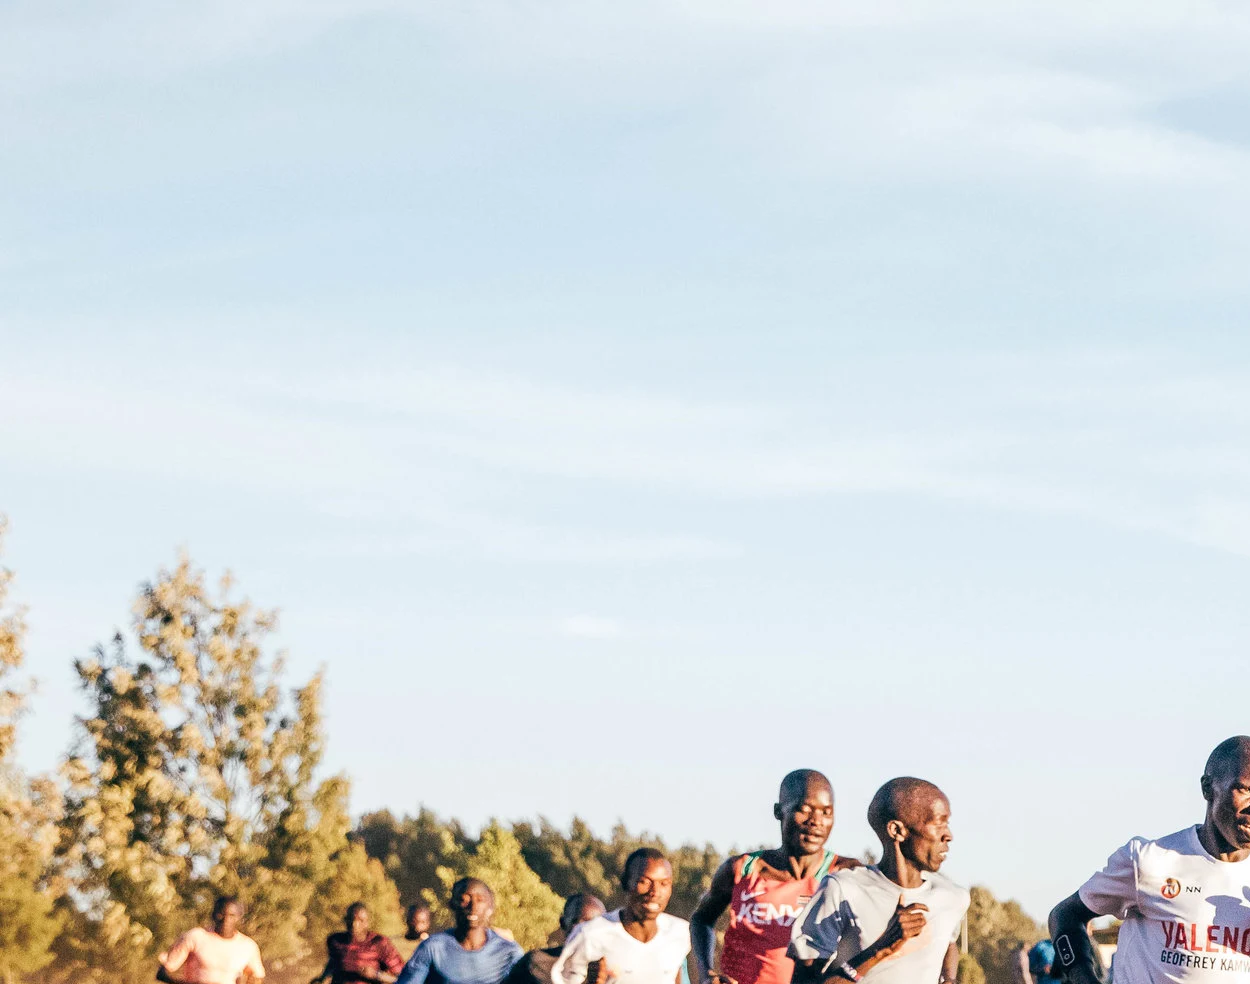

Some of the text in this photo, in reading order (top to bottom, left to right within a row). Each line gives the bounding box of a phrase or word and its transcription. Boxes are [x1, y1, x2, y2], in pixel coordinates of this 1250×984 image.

[1185, 885, 1202, 893] NN
[736, 902, 804, 927] KENY
[1160, 949, 1217, 970] GEOFFREY
